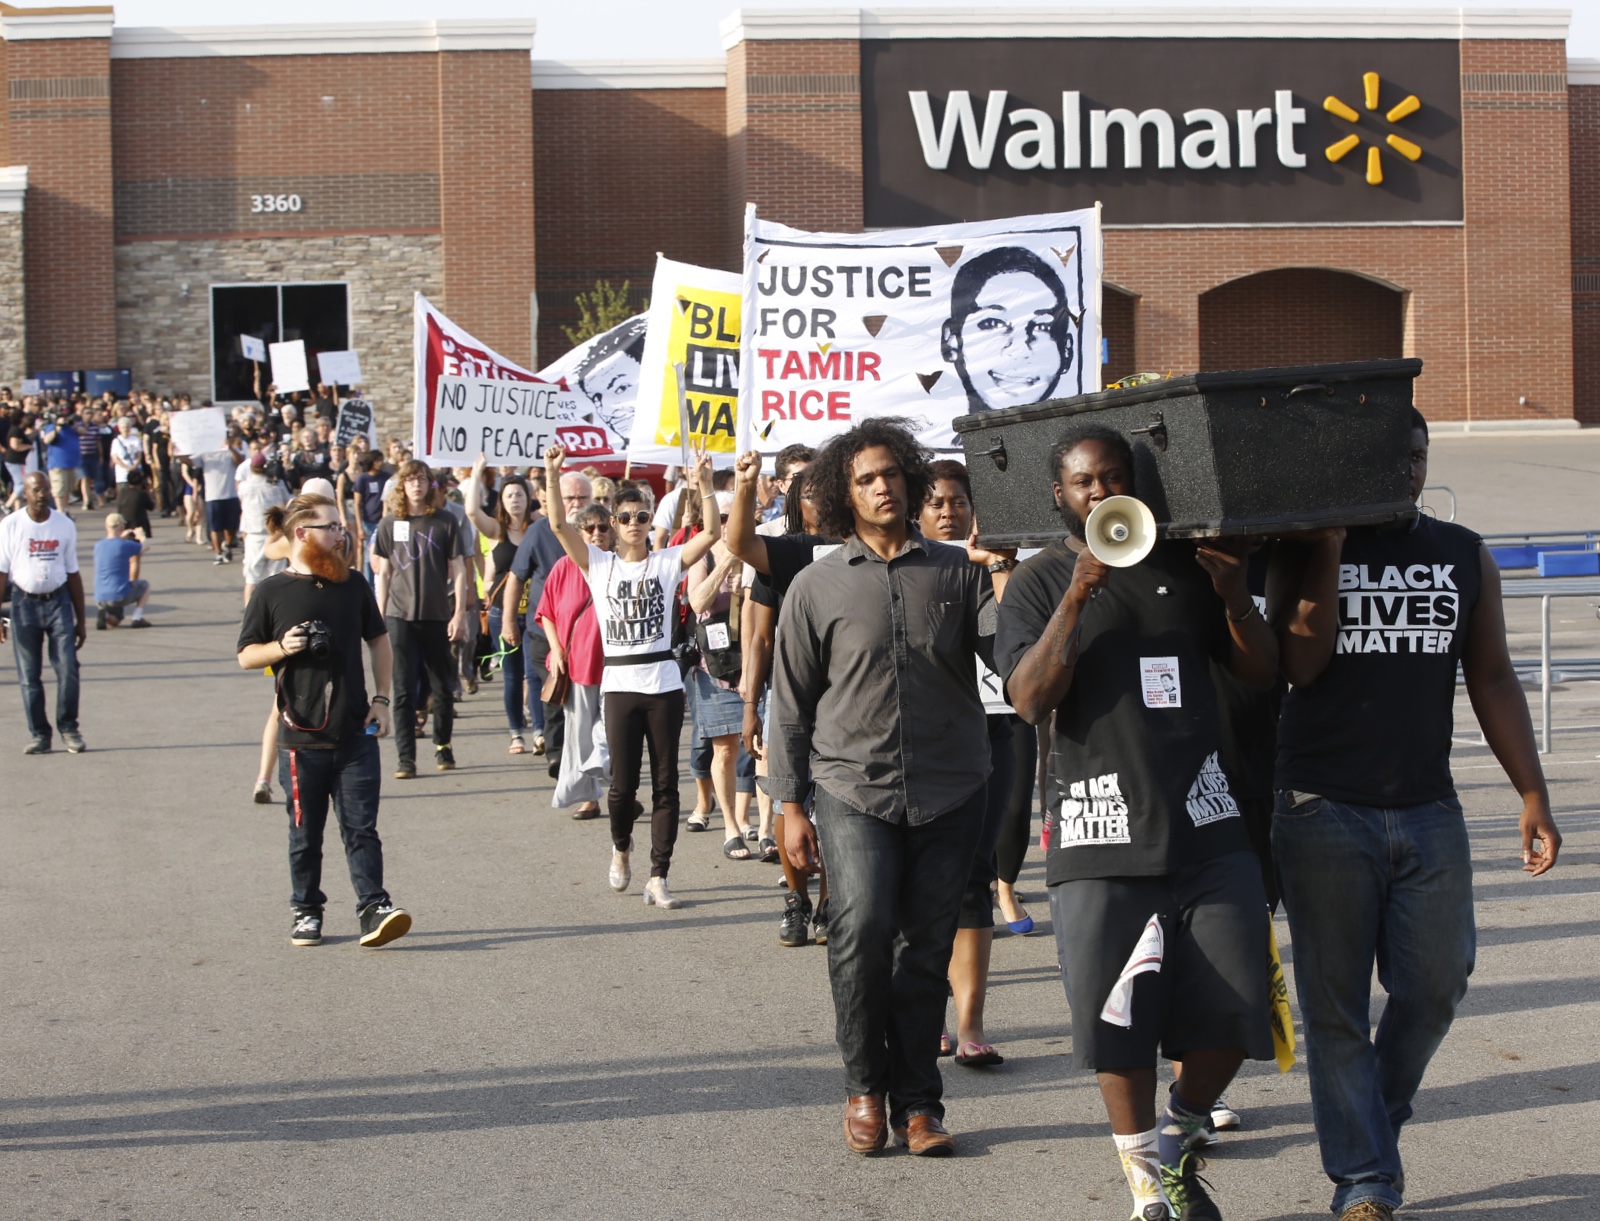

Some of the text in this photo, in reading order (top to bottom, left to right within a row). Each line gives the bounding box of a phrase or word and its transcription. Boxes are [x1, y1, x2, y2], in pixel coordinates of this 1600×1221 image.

[908, 90, 1306, 169] Walmart
[250, 194, 302, 212] 3360
[757, 265, 932, 299] JUSTICE
[690, 301, 741, 343] BL
[759, 308, 837, 339] FOR
[757, 348, 881, 381] TAMIR
[441, 383, 558, 420] NO JUSTICE
[762, 390, 852, 421] RICE
[686, 398, 736, 437] MA
[439, 425, 548, 459] NO PEACE
[29, 540, 59, 552] STOP
[617, 575, 664, 599] BLACK
[1338, 564, 1458, 590] BLACK
[623, 594, 665, 619] LIVES
[1338, 595, 1456, 626] LIVES
[606, 614, 664, 640] MATTER
[1336, 630, 1453, 654] MATTER
[1070, 773, 1122, 798] BLACK
[1197, 772, 1229, 796] LIVES
[1083, 796, 1128, 817] LIVES
[1186, 793, 1238, 821] MATTER
[1060, 815, 1130, 843] MATTER
